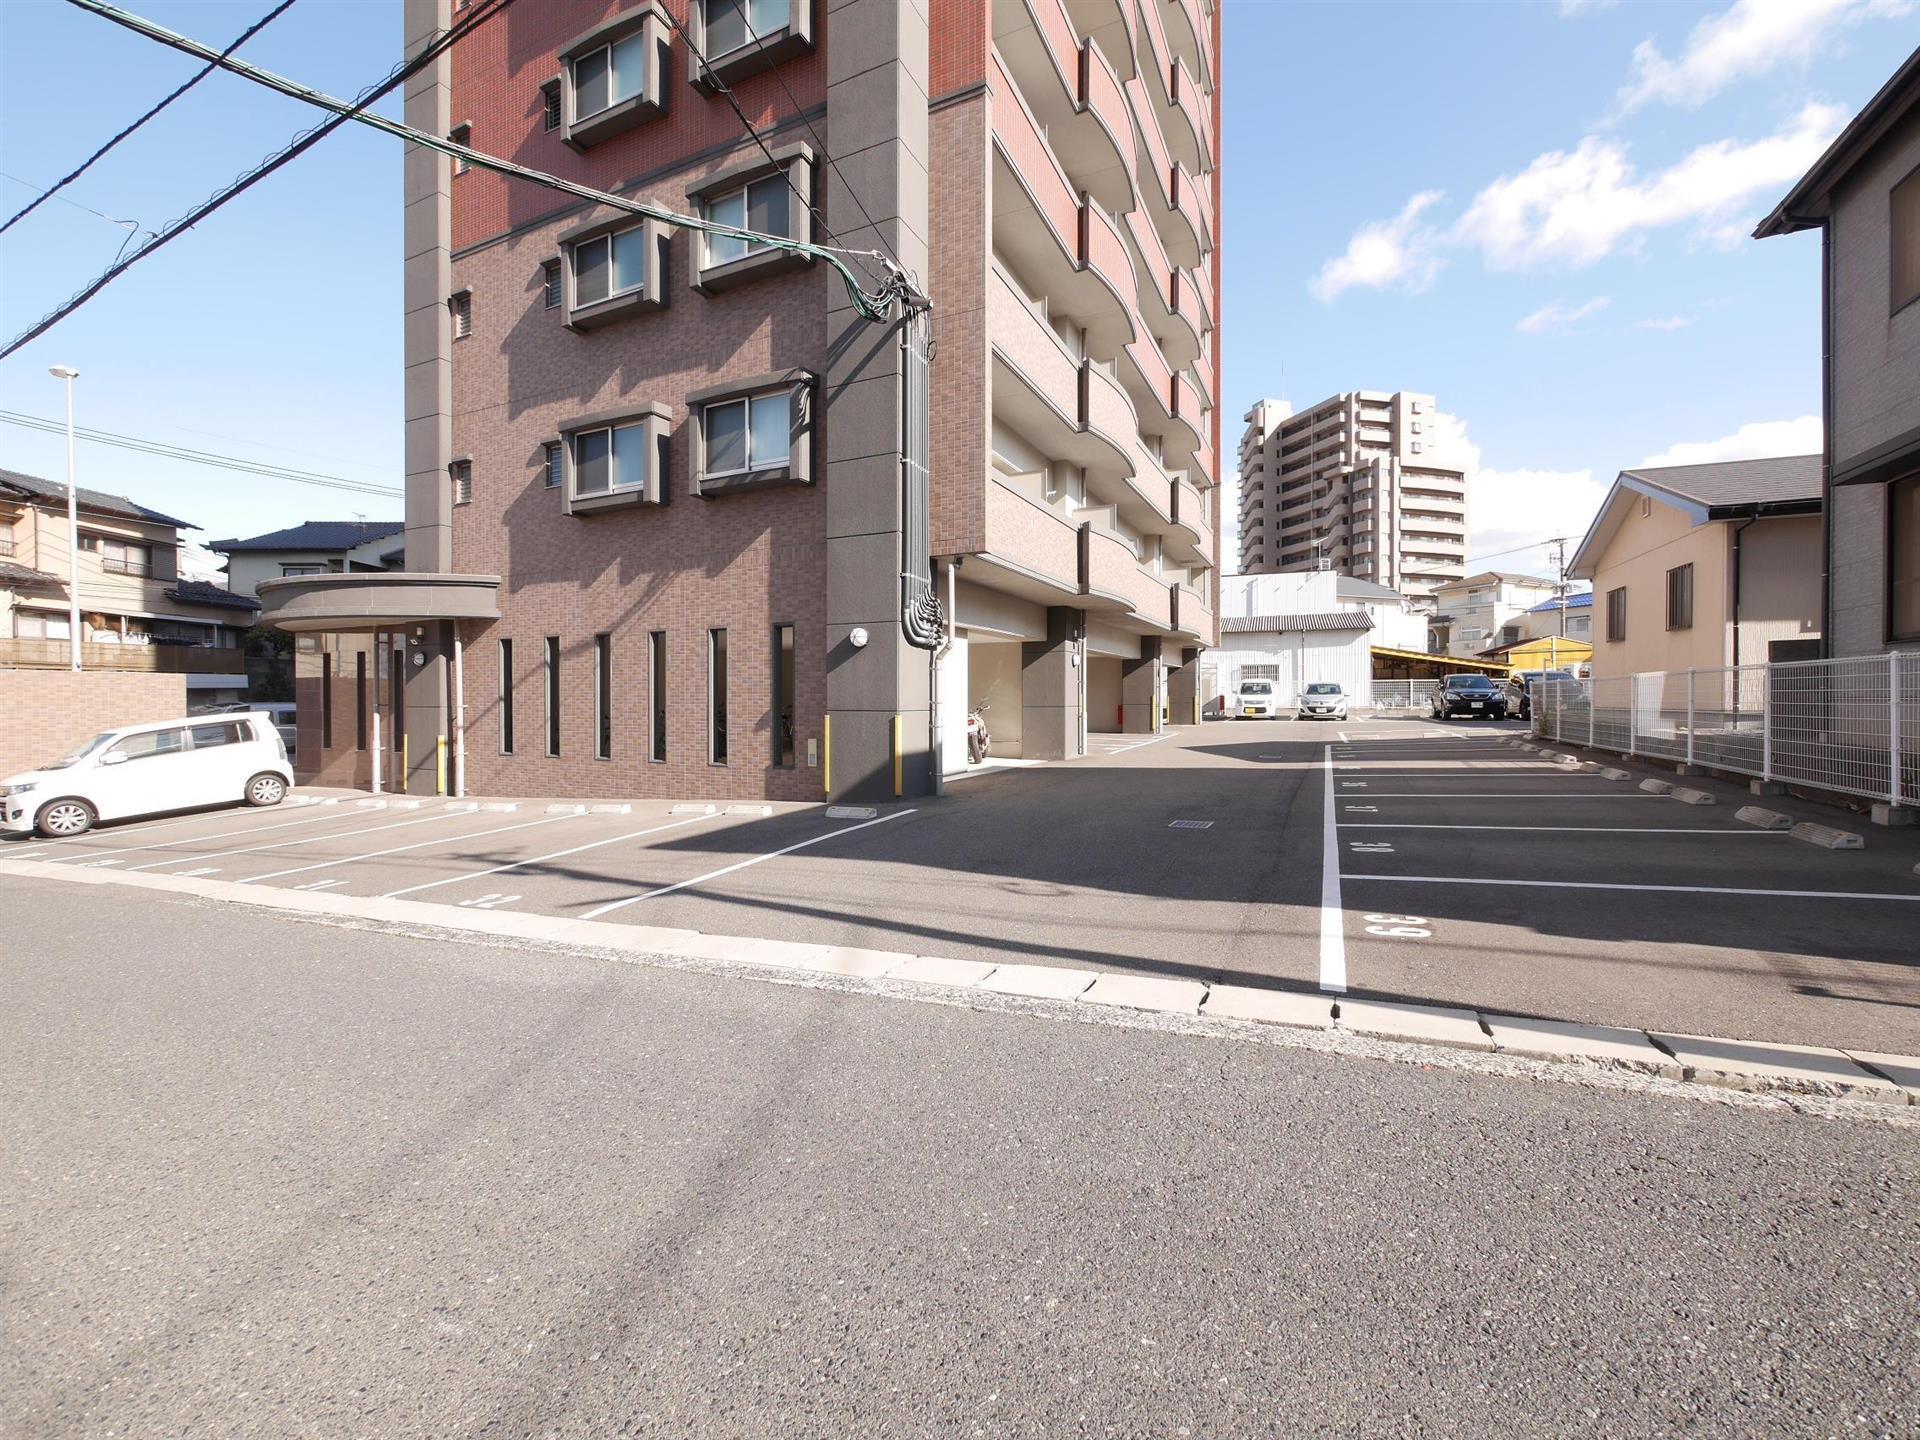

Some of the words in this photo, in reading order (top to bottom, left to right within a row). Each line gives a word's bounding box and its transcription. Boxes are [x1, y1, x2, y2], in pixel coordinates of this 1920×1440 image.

[1350, 841, 1395, 853] 38
[459, 893, 523, 909] 32
[1363, 914, 1432, 938] 39
